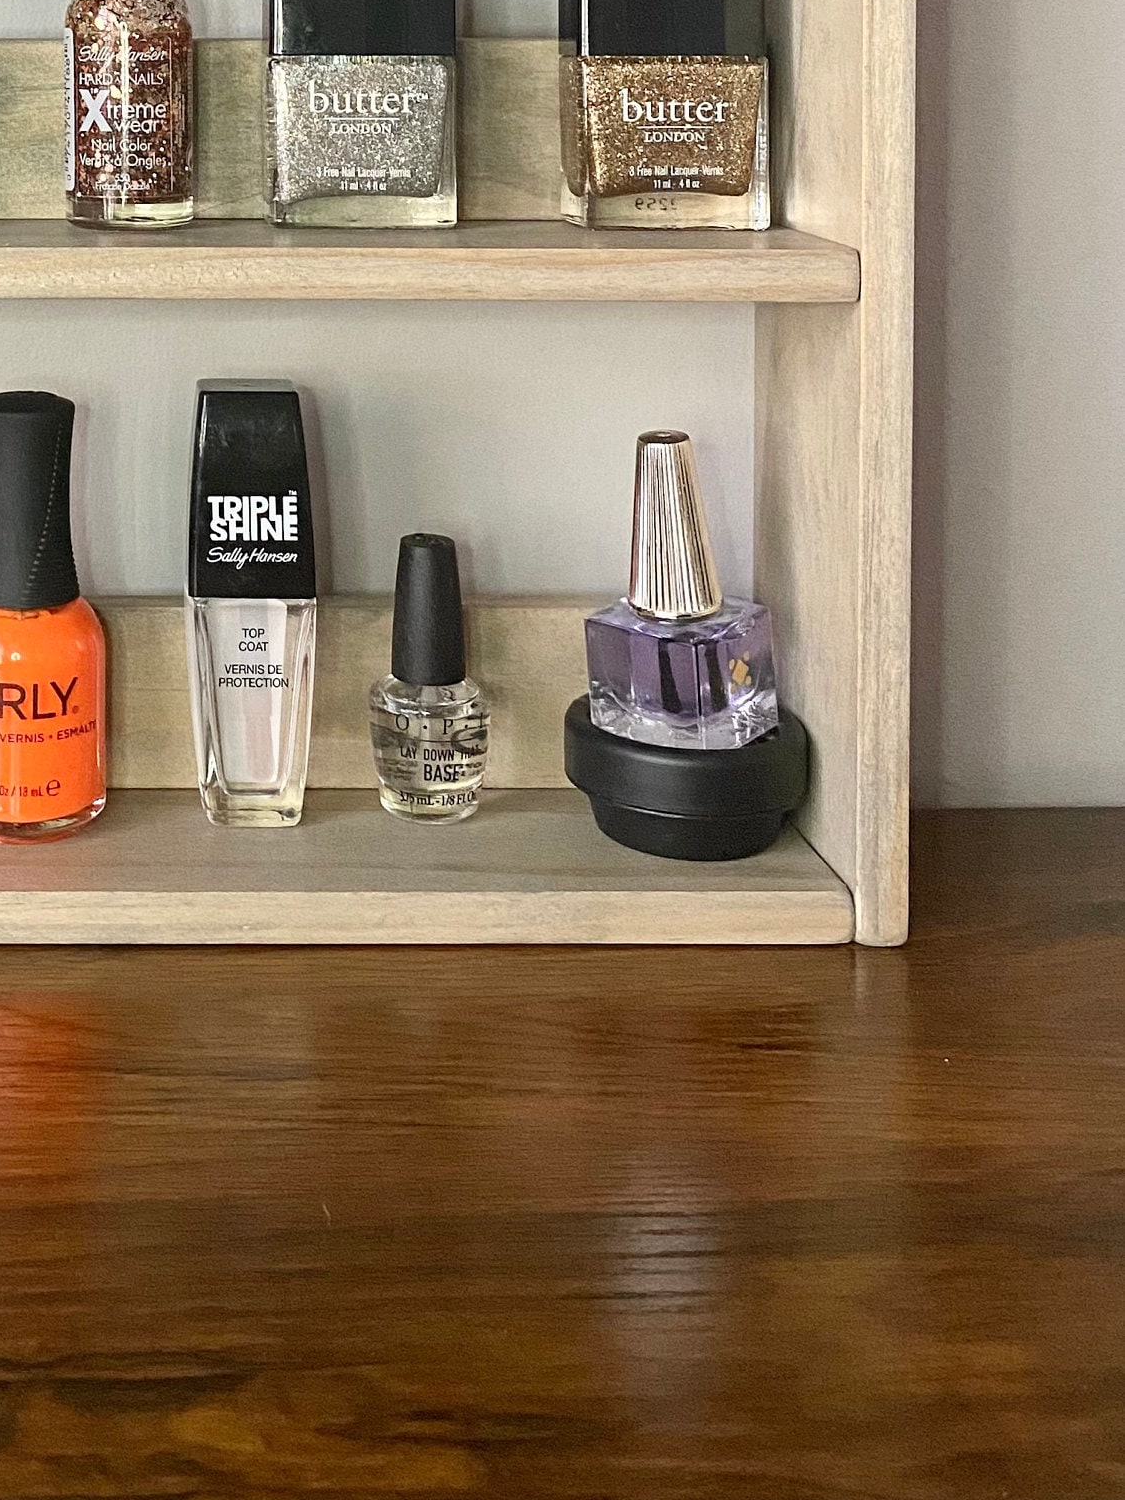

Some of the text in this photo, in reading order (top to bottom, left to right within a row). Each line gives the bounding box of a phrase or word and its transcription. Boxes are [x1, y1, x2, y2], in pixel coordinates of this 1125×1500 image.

[78, 45, 115, 67] Sally
[79, 72, 164, 86] HARD NAILS
[309, 79, 413, 114] butter
[79, 89, 167, 132] Xtreme
[618, 87, 729, 123] butter
[114, 119, 159, 133] wear
[332, 123, 393, 135] LONDON
[91, 136, 153, 152] Nail Color
[643, 131, 706, 143] LONDON
[126, 153, 167, 170] Ongles
[324, 166, 339, 178] Free
[637, 166, 652, 177] Free
[654, 165, 668, 176] Nail
[653, 180, 661, 189] 11
[206, 495, 298, 522] TRIPLE
[209, 514, 299, 542] SHINE
[206, 546, 298, 569] Sally Hansen
[241, 627, 265, 639] TOP
[238, 641, 268, 652] COAT
[224, 664, 283, 675] VERNIS DE
[218, 677, 289, 689] PROTECTION
[0, 733, 46, 743] VERNIS
[56, 719, 98, 741] ESMALTE
[400, 745, 455, 761] LAY DOWN
[423, 763, 460, 781] BASE
[31, 785, 44, 797] mL
[416, 794, 434, 806] mL
